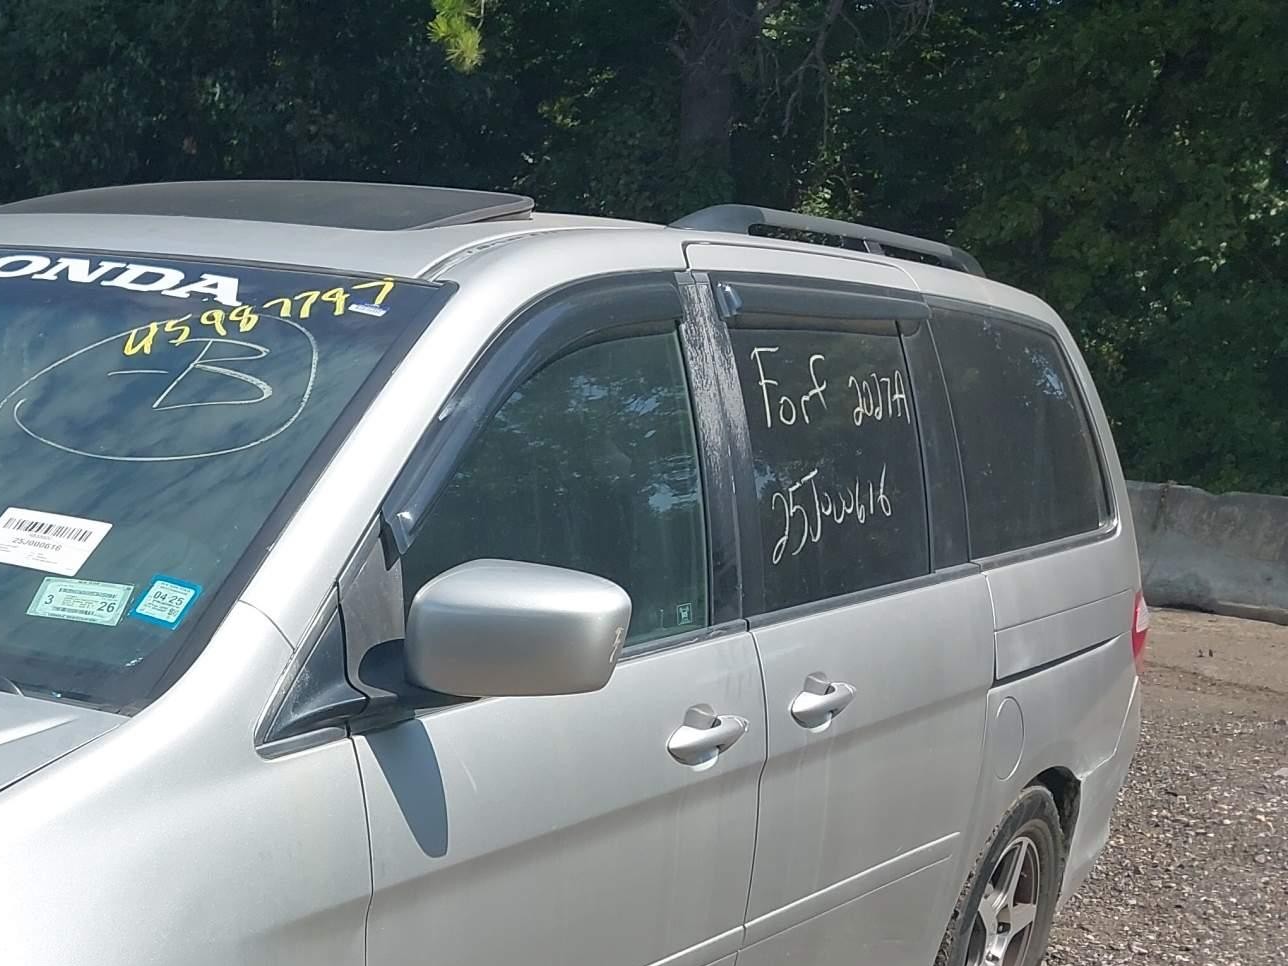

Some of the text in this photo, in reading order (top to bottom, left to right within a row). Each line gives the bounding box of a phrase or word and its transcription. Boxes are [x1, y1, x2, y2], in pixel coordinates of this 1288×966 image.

[12, 537, 62, 552] 25J000616
[44, 594, 54, 605] 3
[97, 601, 116, 613] 26
[153, 591, 168, 600] 04
[168, 595, 185, 606] 25
